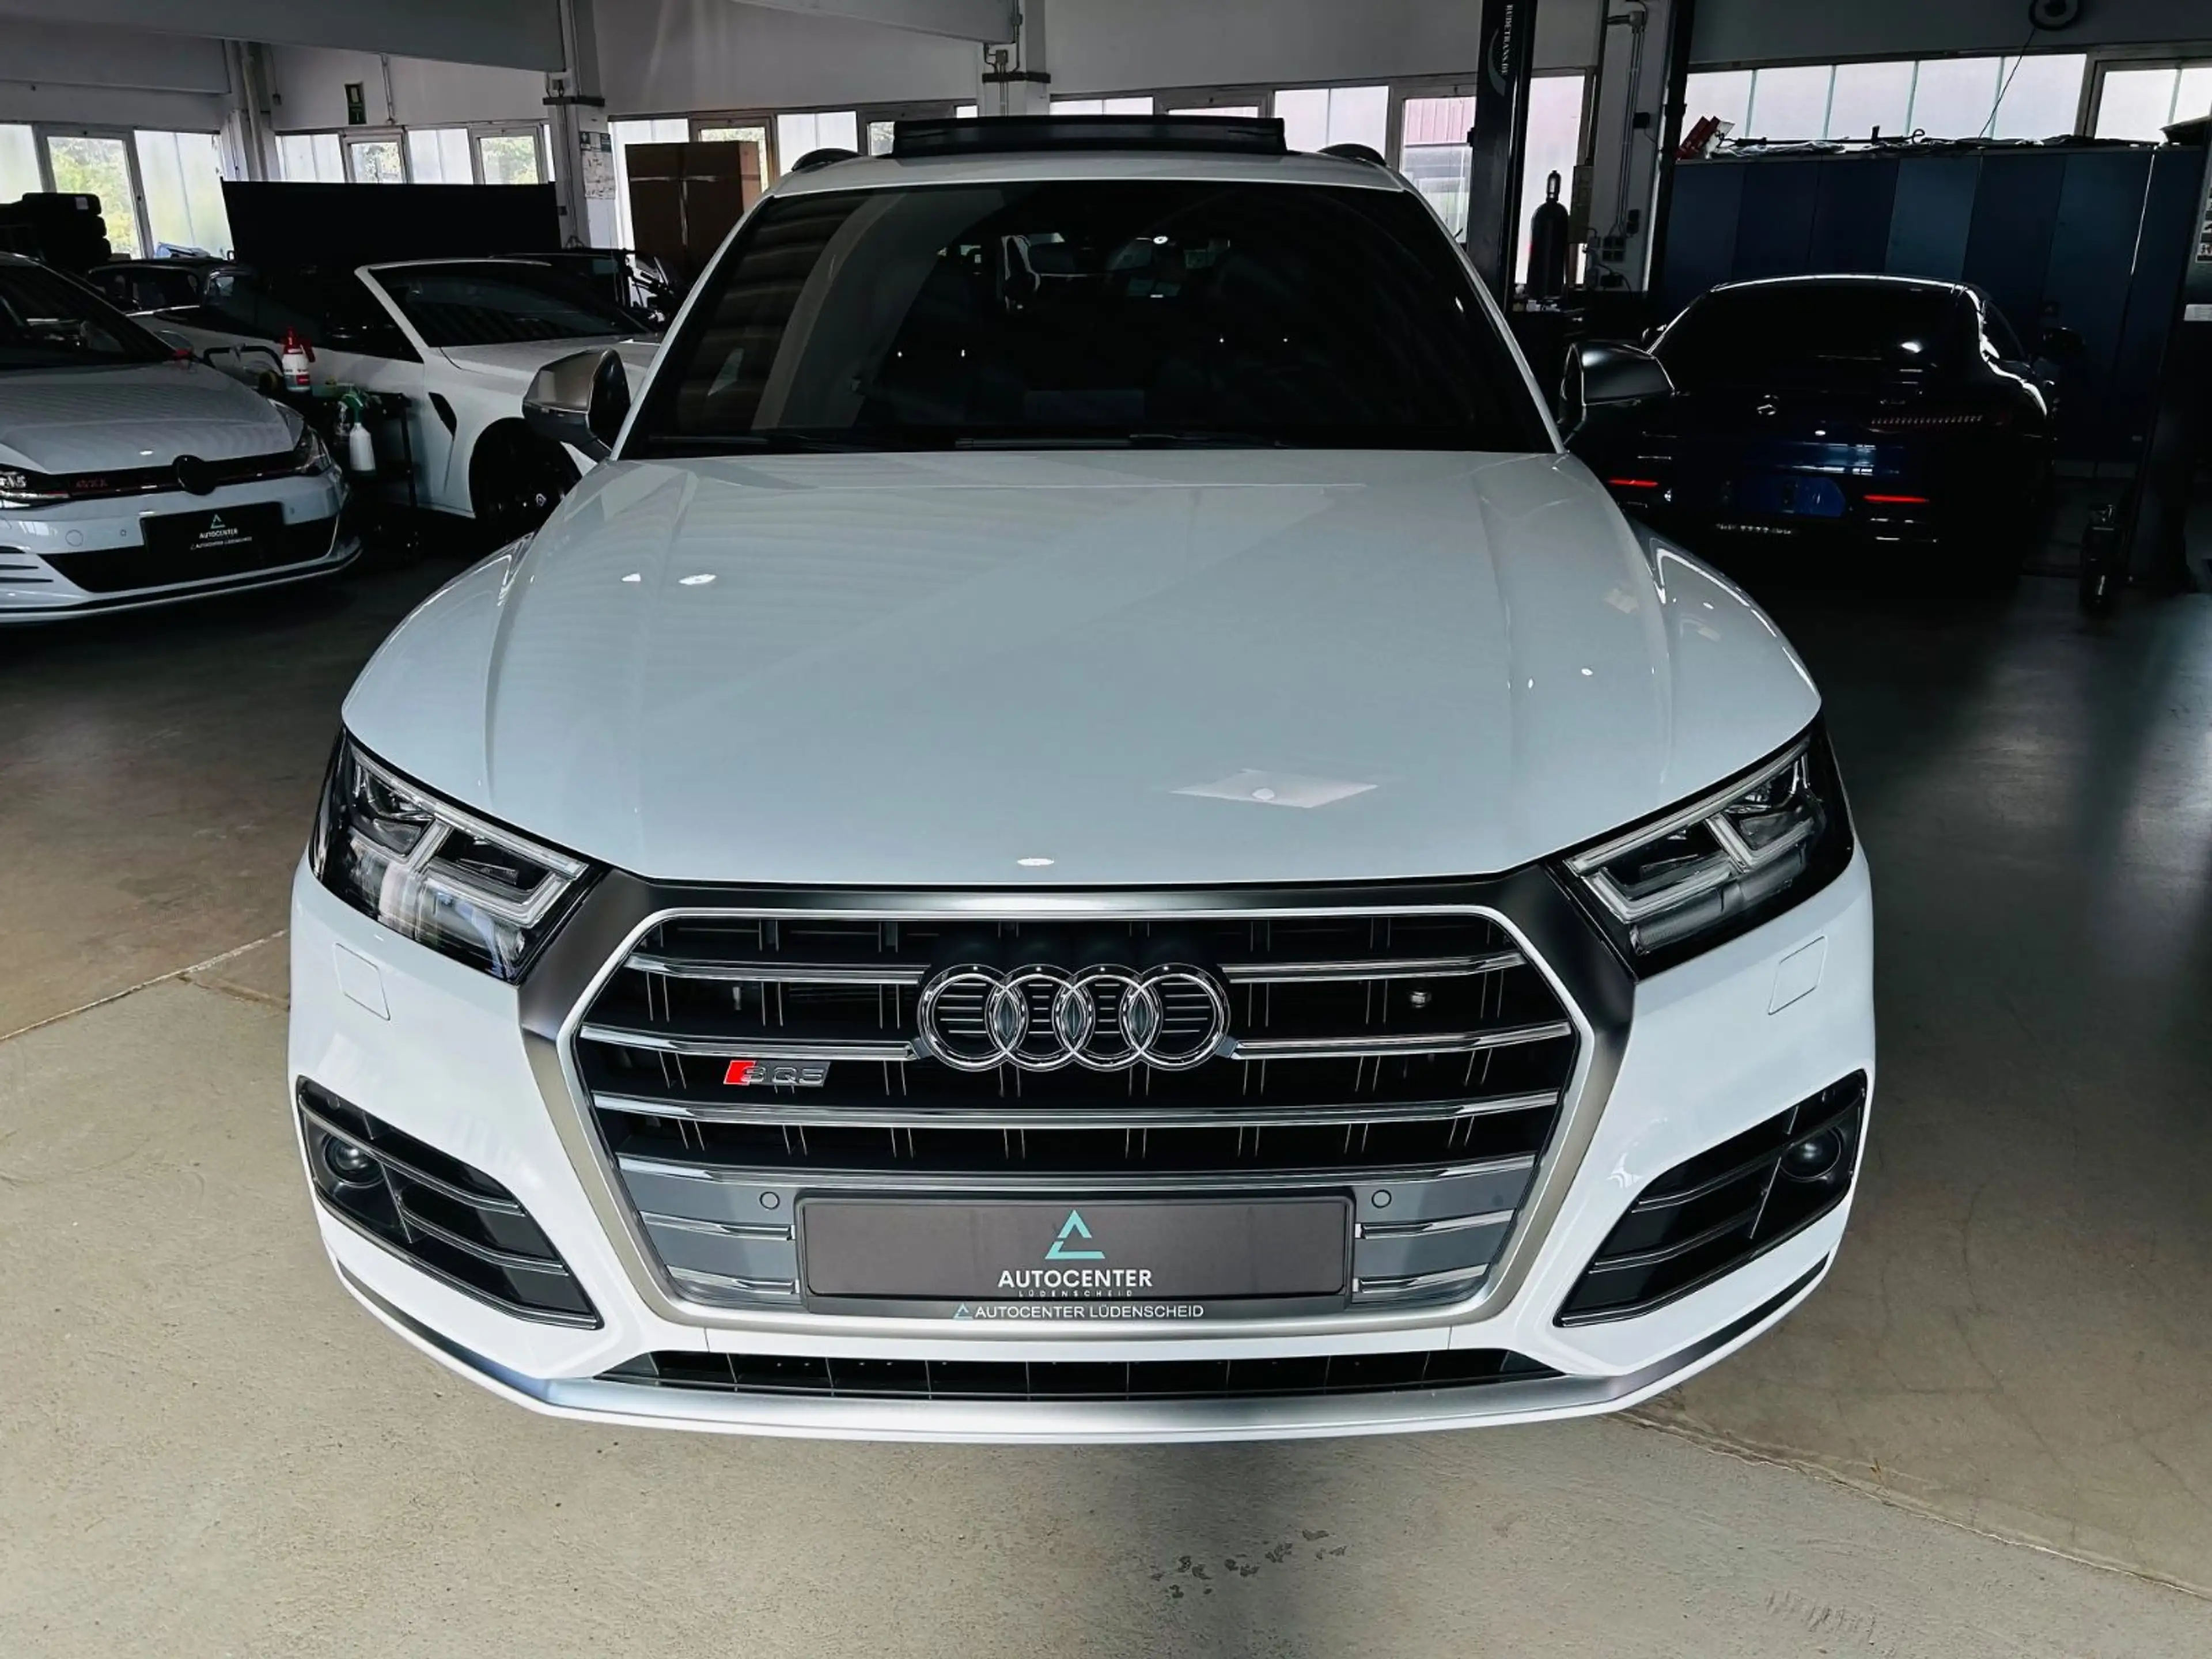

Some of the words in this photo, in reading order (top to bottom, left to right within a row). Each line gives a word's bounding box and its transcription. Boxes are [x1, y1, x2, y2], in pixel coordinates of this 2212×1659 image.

[741, 1066, 824, 1085] SQ5
[997, 1269, 1153, 1288] AUTOCENTER
[1018, 1289, 1132, 1297] LÜDENSCHEID
[975, 1305, 1086, 1319] AUTOCENTER
[1089, 1304, 1204, 1318] LÜDENSCHEID
